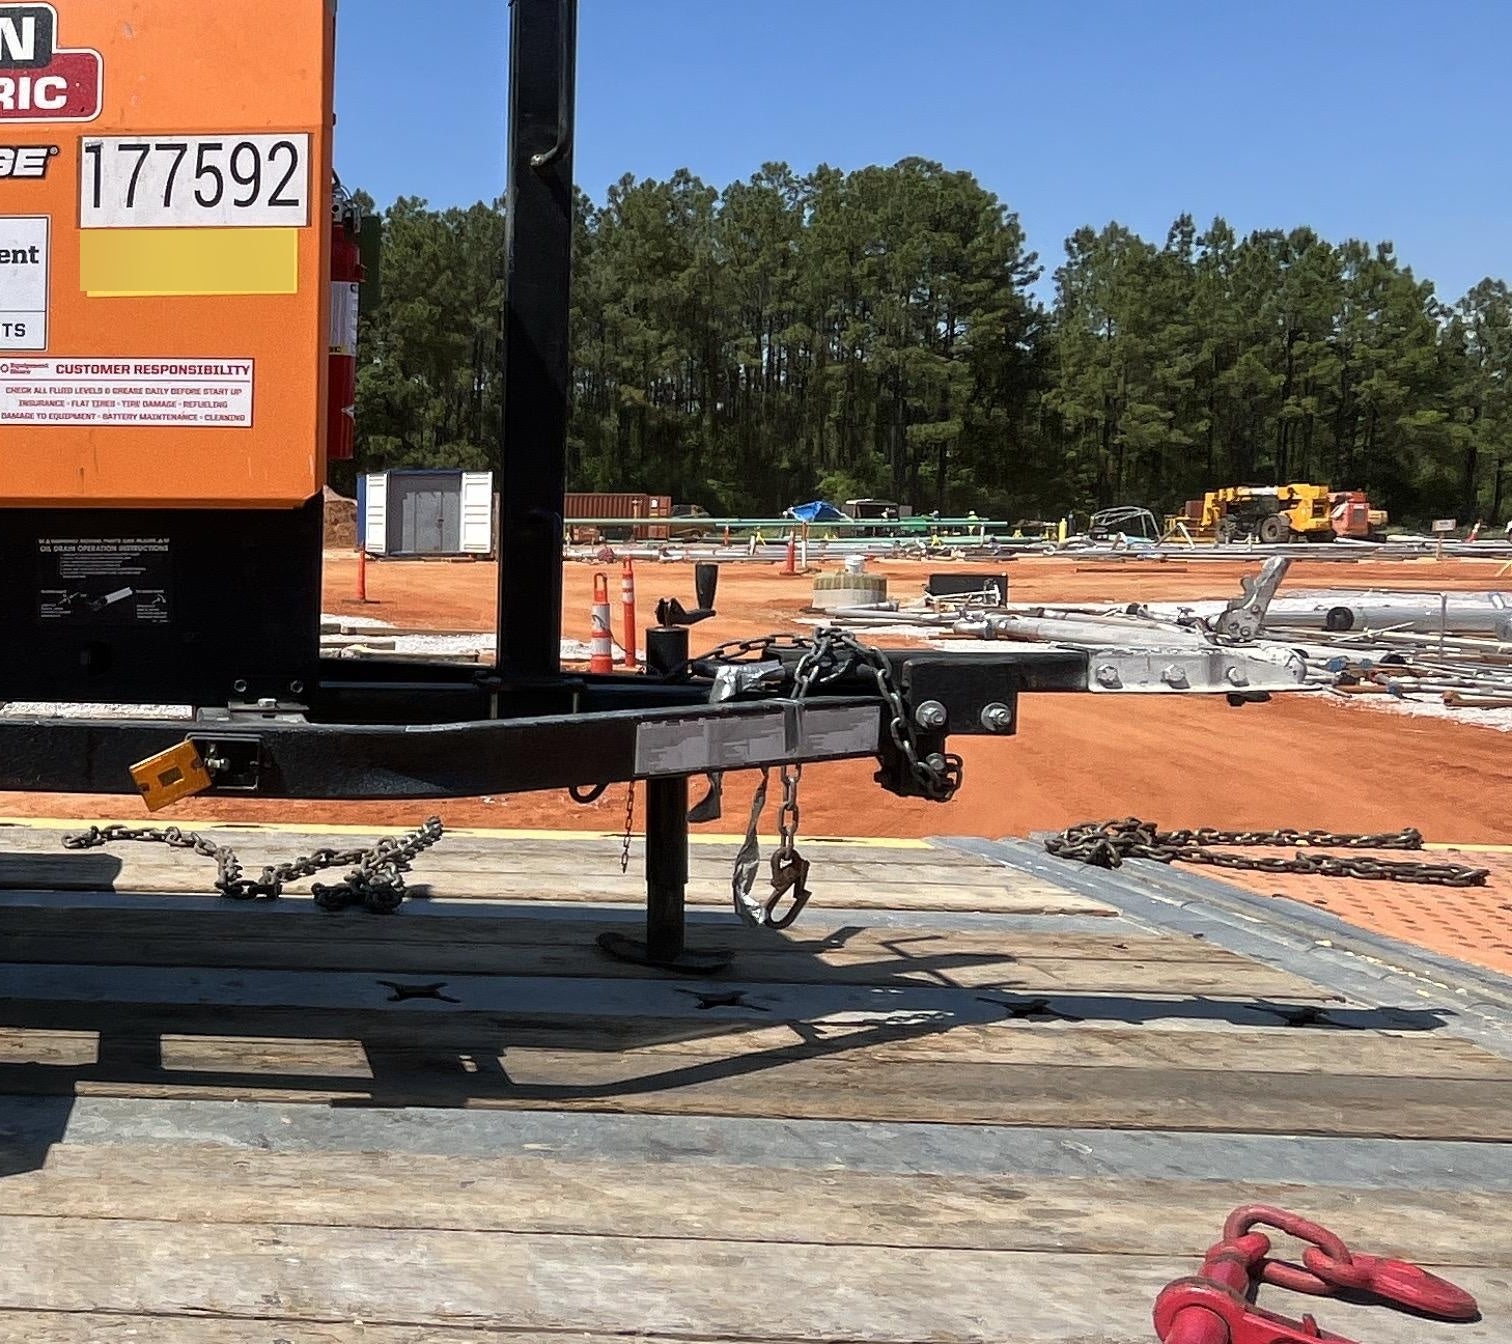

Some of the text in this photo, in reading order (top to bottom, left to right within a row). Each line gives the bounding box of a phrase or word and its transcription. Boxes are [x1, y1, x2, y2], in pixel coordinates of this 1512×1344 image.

[84, 140, 300, 209] 177592
[55, 364, 131, 375] CUSTOMER
[133, 364, 250, 376] RESPONSIBILITY
[5, 386, 32, 394] CHECK
[49, 387, 74, 395] FLUID
[74, 387, 103, 395] LEVELS
[112, 387, 144, 395] GREASE
[145, 387, 169, 395] DAILY
[170, 387, 201, 395] BEFORE
[203, 388, 229, 396] START
[230, 388, 243, 396] UP
[18, 399, 65, 407] INSURANCE
[71, 399, 89, 407] FLAT
[142, 400, 176, 408] DAMAGE
[183, 401, 228, 409] REFUELING
[1, 412, 34, 420] DAMAGE
[48, 412, 96, 421] EQUIPMENT
[102, 413, 137, 421] BATTERY
[139, 413, 198, 421] MAINTENANCE
[204, 414, 246, 422] CLEANING
